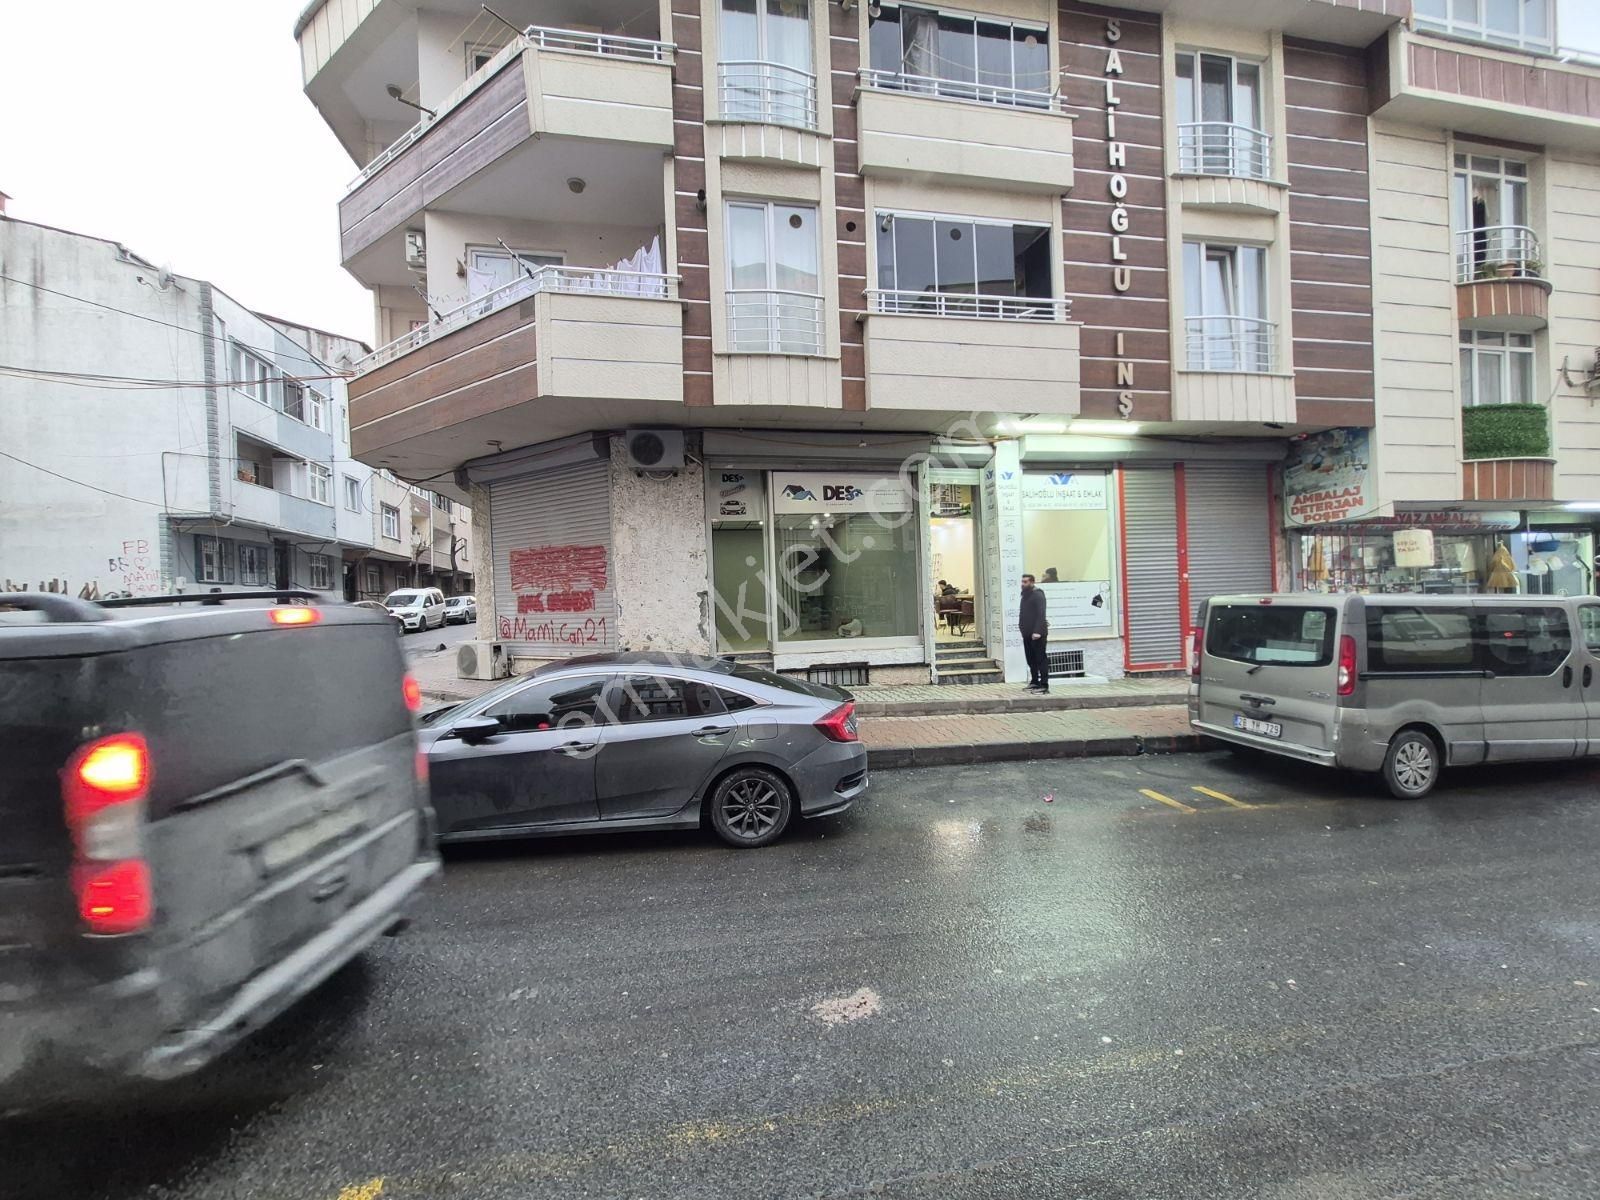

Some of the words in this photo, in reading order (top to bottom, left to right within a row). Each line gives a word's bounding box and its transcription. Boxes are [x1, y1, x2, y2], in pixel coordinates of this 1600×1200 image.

[1293, 486, 1361, 505] AMBALAJ
[1291, 496, 1364, 516] DETERJAN
[1304, 510, 1349, 523] POŞET
[123, 540, 149, 554] FB
